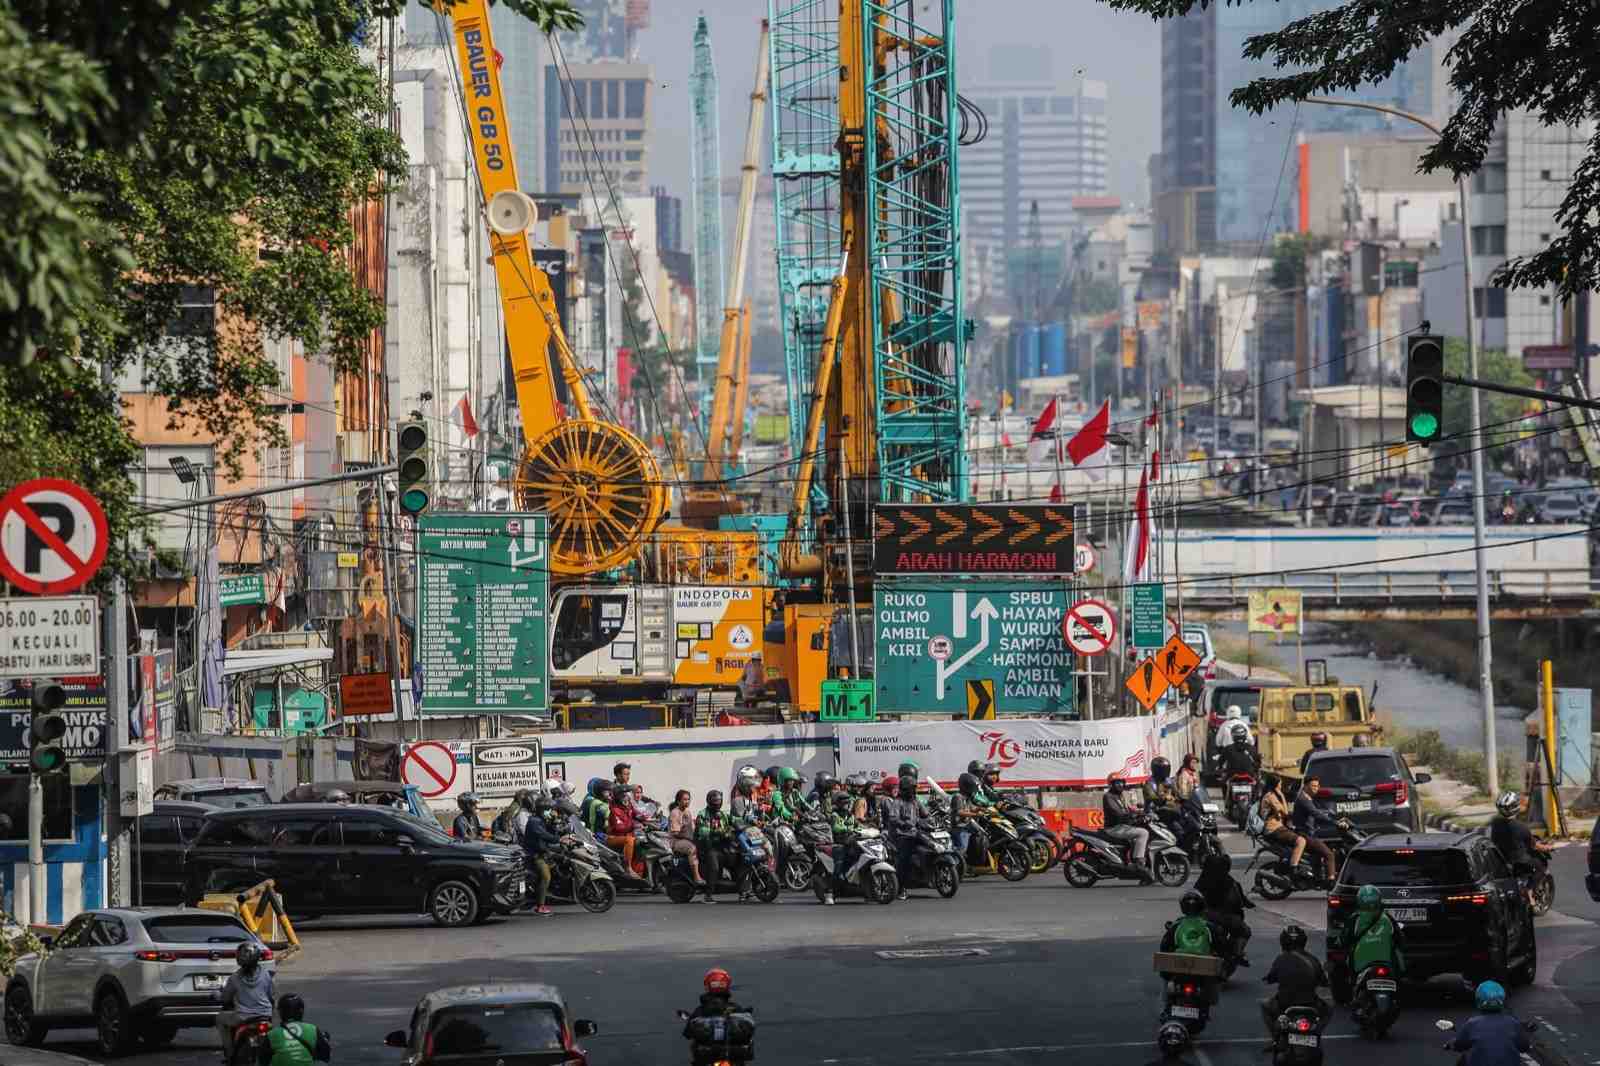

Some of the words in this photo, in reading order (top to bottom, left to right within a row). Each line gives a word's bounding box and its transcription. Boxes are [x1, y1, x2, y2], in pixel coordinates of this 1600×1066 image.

[463, 30, 491, 99] BAUER
[477, 106, 497, 140] GB
[483, 143, 504, 171] 50
[896, 552, 951, 569] ARAH
[959, 552, 1057, 569] HARMONI
[678, 589, 750, 599] INDOPORA
[884, 594, 926, 606] RUKO
[1010, 592, 1053, 605] SPBU
[53, 608, 91, 626] 20.00
[880, 611, 930, 623] OLIMO
[1002, 607, 1060, 621] HAYAM
[881, 627, 930, 640] AMBIL
[1001, 622, 1062, 636] WURUK
[12, 634, 78, 650] KECUALI
[1000, 637, 1064, 651] SAMPAI
[888, 644, 922, 657] KIRI
[38, 654, 62, 667] HARI
[65, 653, 92, 666] LIBUR
[992, 653, 1072, 666] HARMONI
[1006, 668, 1058, 682] AMBIL
[1004, 684, 1061, 697] KANAN
[825, 694, 872, 717] M-1
[854, 736, 898, 744] DIRGAHAYU
[1024, 738, 1082, 749] NUSANTARA
[1084, 738, 1109, 747] BARU
[484, 751, 503, 760] HATI
[509, 750, 528, 758] HATI
[854, 744, 890, 753] REPUBLIK
[891, 744, 932, 752] INDONESIA
[1024, 749, 1076, 760] INDONESIA
[1078, 748, 1105, 758] MAJU
[476, 771, 508, 782] KELUAR
[509, 770, 537, 780] MASUK
[475, 781, 513, 789] KENDARAAN
